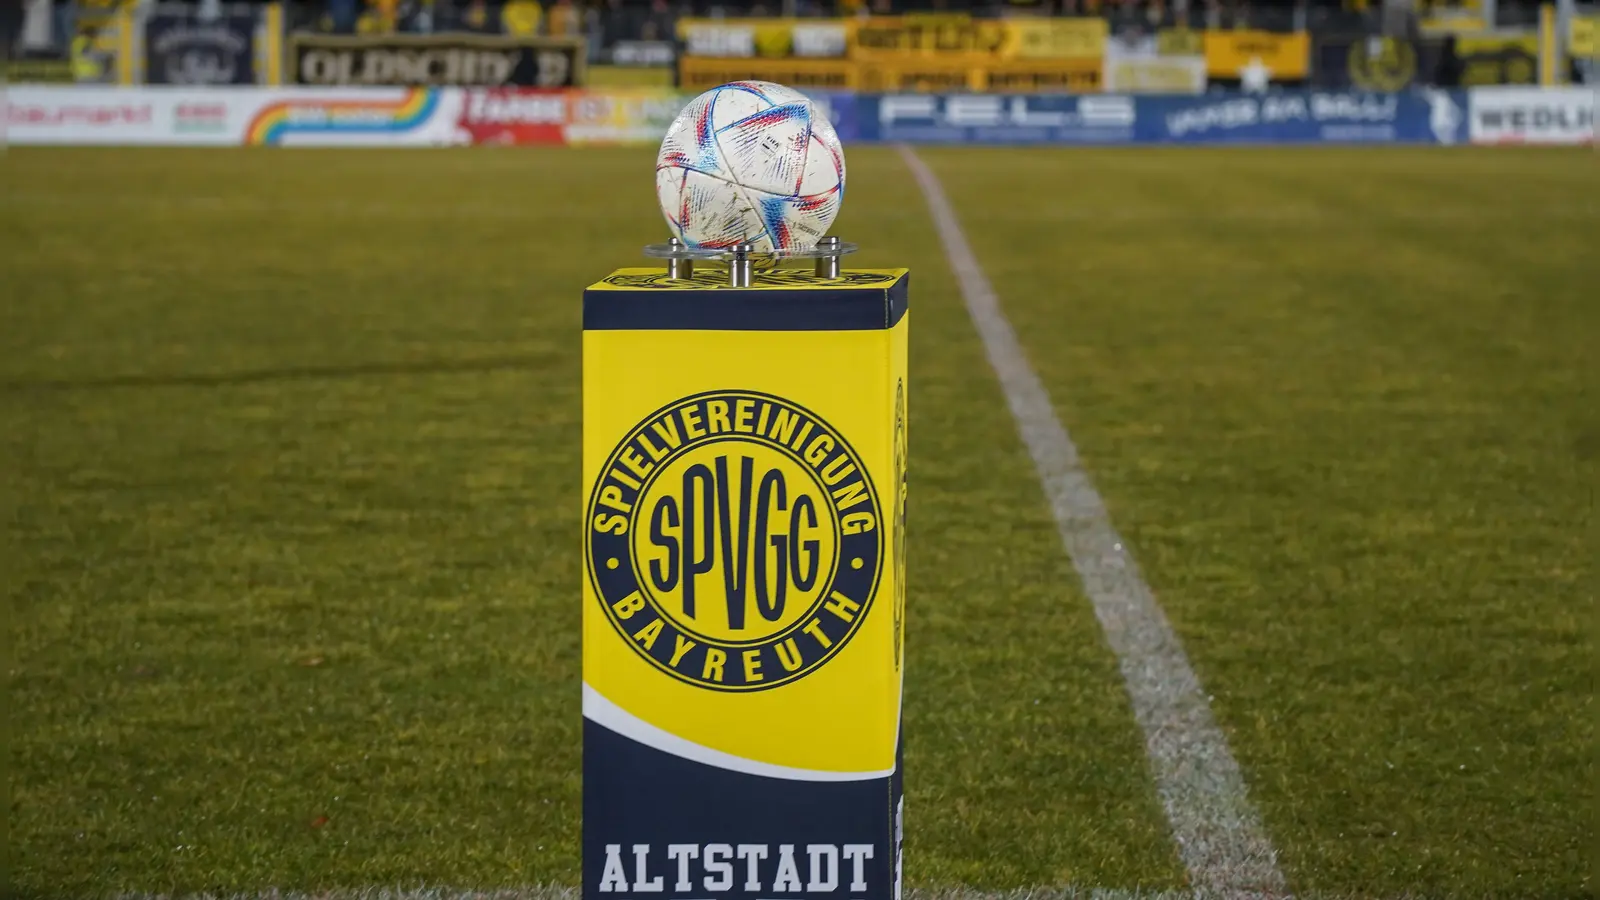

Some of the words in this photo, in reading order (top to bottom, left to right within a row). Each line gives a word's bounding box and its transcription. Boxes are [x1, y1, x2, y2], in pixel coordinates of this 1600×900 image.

[593, 398, 876, 537] SPIELVEREINIGUNG
[648, 455, 820, 630] SPVGG
[611, 590, 861, 683] BAYREUTH
[599, 843, 874, 892] ALTSTADT
